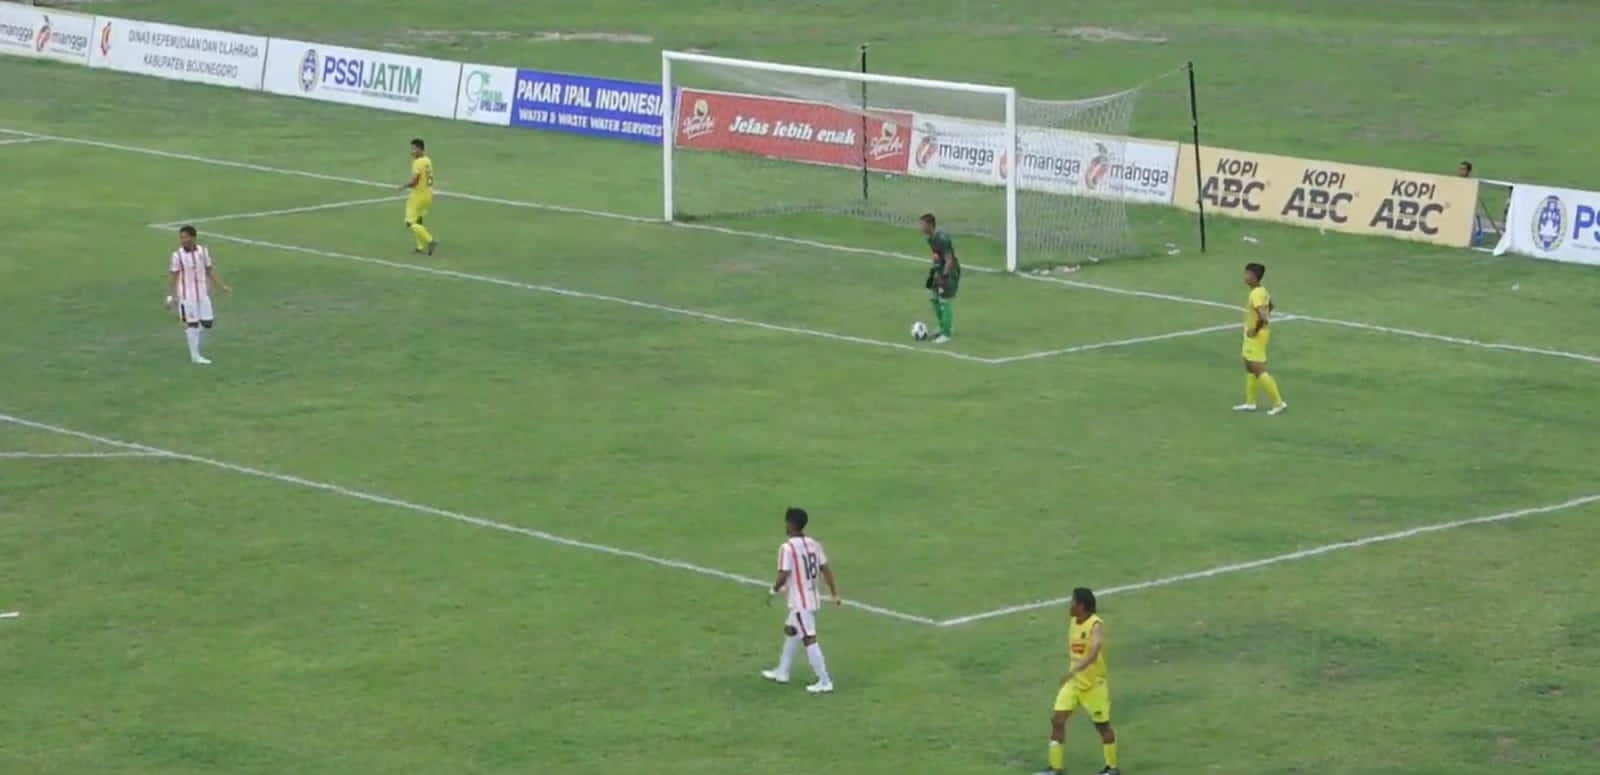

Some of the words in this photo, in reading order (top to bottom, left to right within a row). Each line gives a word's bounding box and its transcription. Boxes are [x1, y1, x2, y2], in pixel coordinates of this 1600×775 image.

[51, 31, 88, 51] mangga
[201, 39, 217, 53] DAN
[143, 53, 185, 71] KABUPATEN
[516, 79, 561, 104] PAKAR
[563, 85, 592, 108] IPAL
[518, 108, 548, 122] WATER
[557, 113, 588, 128] WASTE
[589, 116, 620, 132] WATER
[729, 115, 769, 136] Jelas
[772, 121, 813, 141] lebih
[816, 127, 856, 145] enak
[938, 142, 995, 167] mangga
[1022, 151, 1081, 177] mangga
[1110, 164, 1169, 187] mangga
[1216, 157, 1258, 178] KOPI
[1302, 168, 1346, 189] KOPI
[1201, 176, 1265, 212] ABC
[1391, 179, 1436, 199] KOPI
[1281, 187, 1353, 223] ABC
[1369, 198, 1444, 235] ABC
[801, 552, 817, 580] 18
